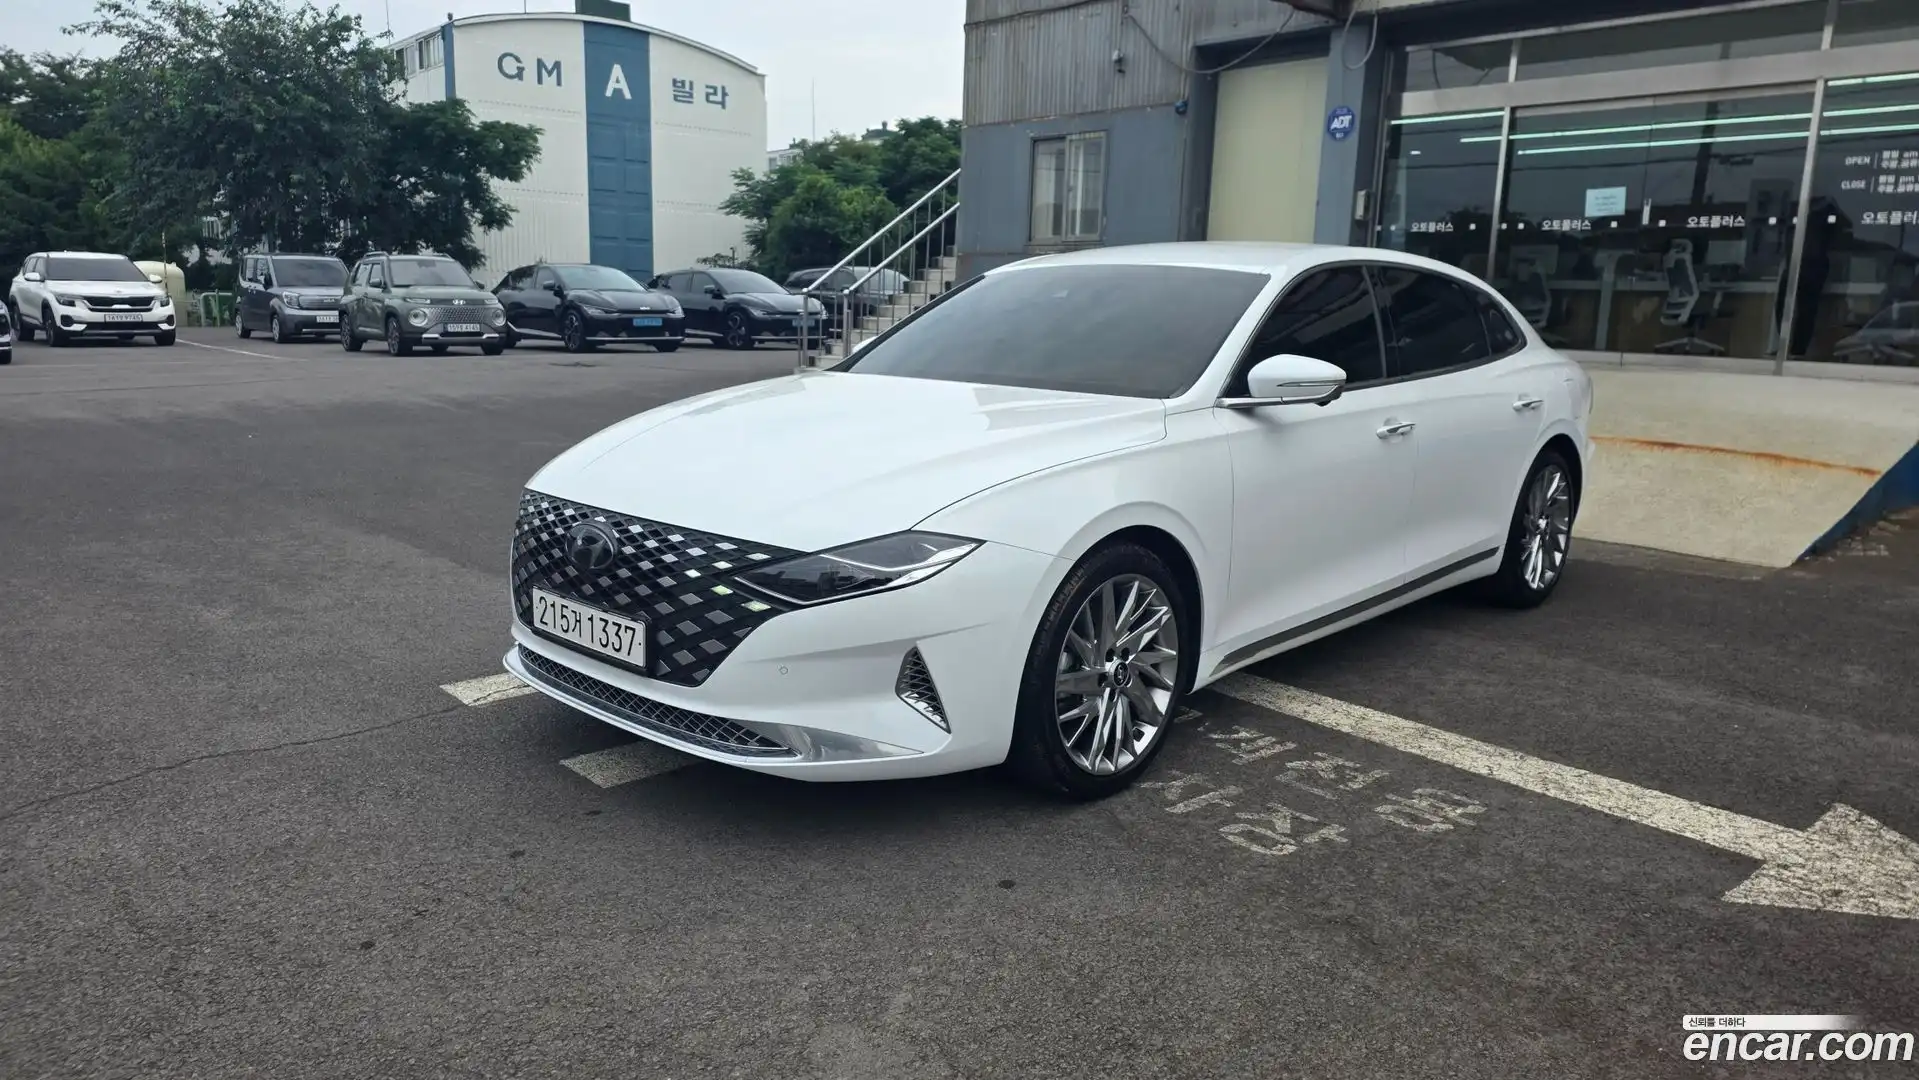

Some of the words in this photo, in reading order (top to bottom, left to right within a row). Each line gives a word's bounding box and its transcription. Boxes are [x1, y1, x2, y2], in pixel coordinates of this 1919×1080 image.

[497, 51, 563, 87] GM
[605, 63, 632, 100] A
[672, 77, 729, 110] 빌라
[1330, 115, 1352, 130] ADT
[1845, 155, 1871, 166] OPEN
[1841, 180, 1866, 190] CLOSE
[1541, 219, 1591, 231] 오토플러스
[1686, 215, 1746, 229] 오토플러스
[1861, 210, 1919, 226] 오토플러
[1410, 221, 1454, 233] 오토플러스
[587, 613, 636, 657] 1337
